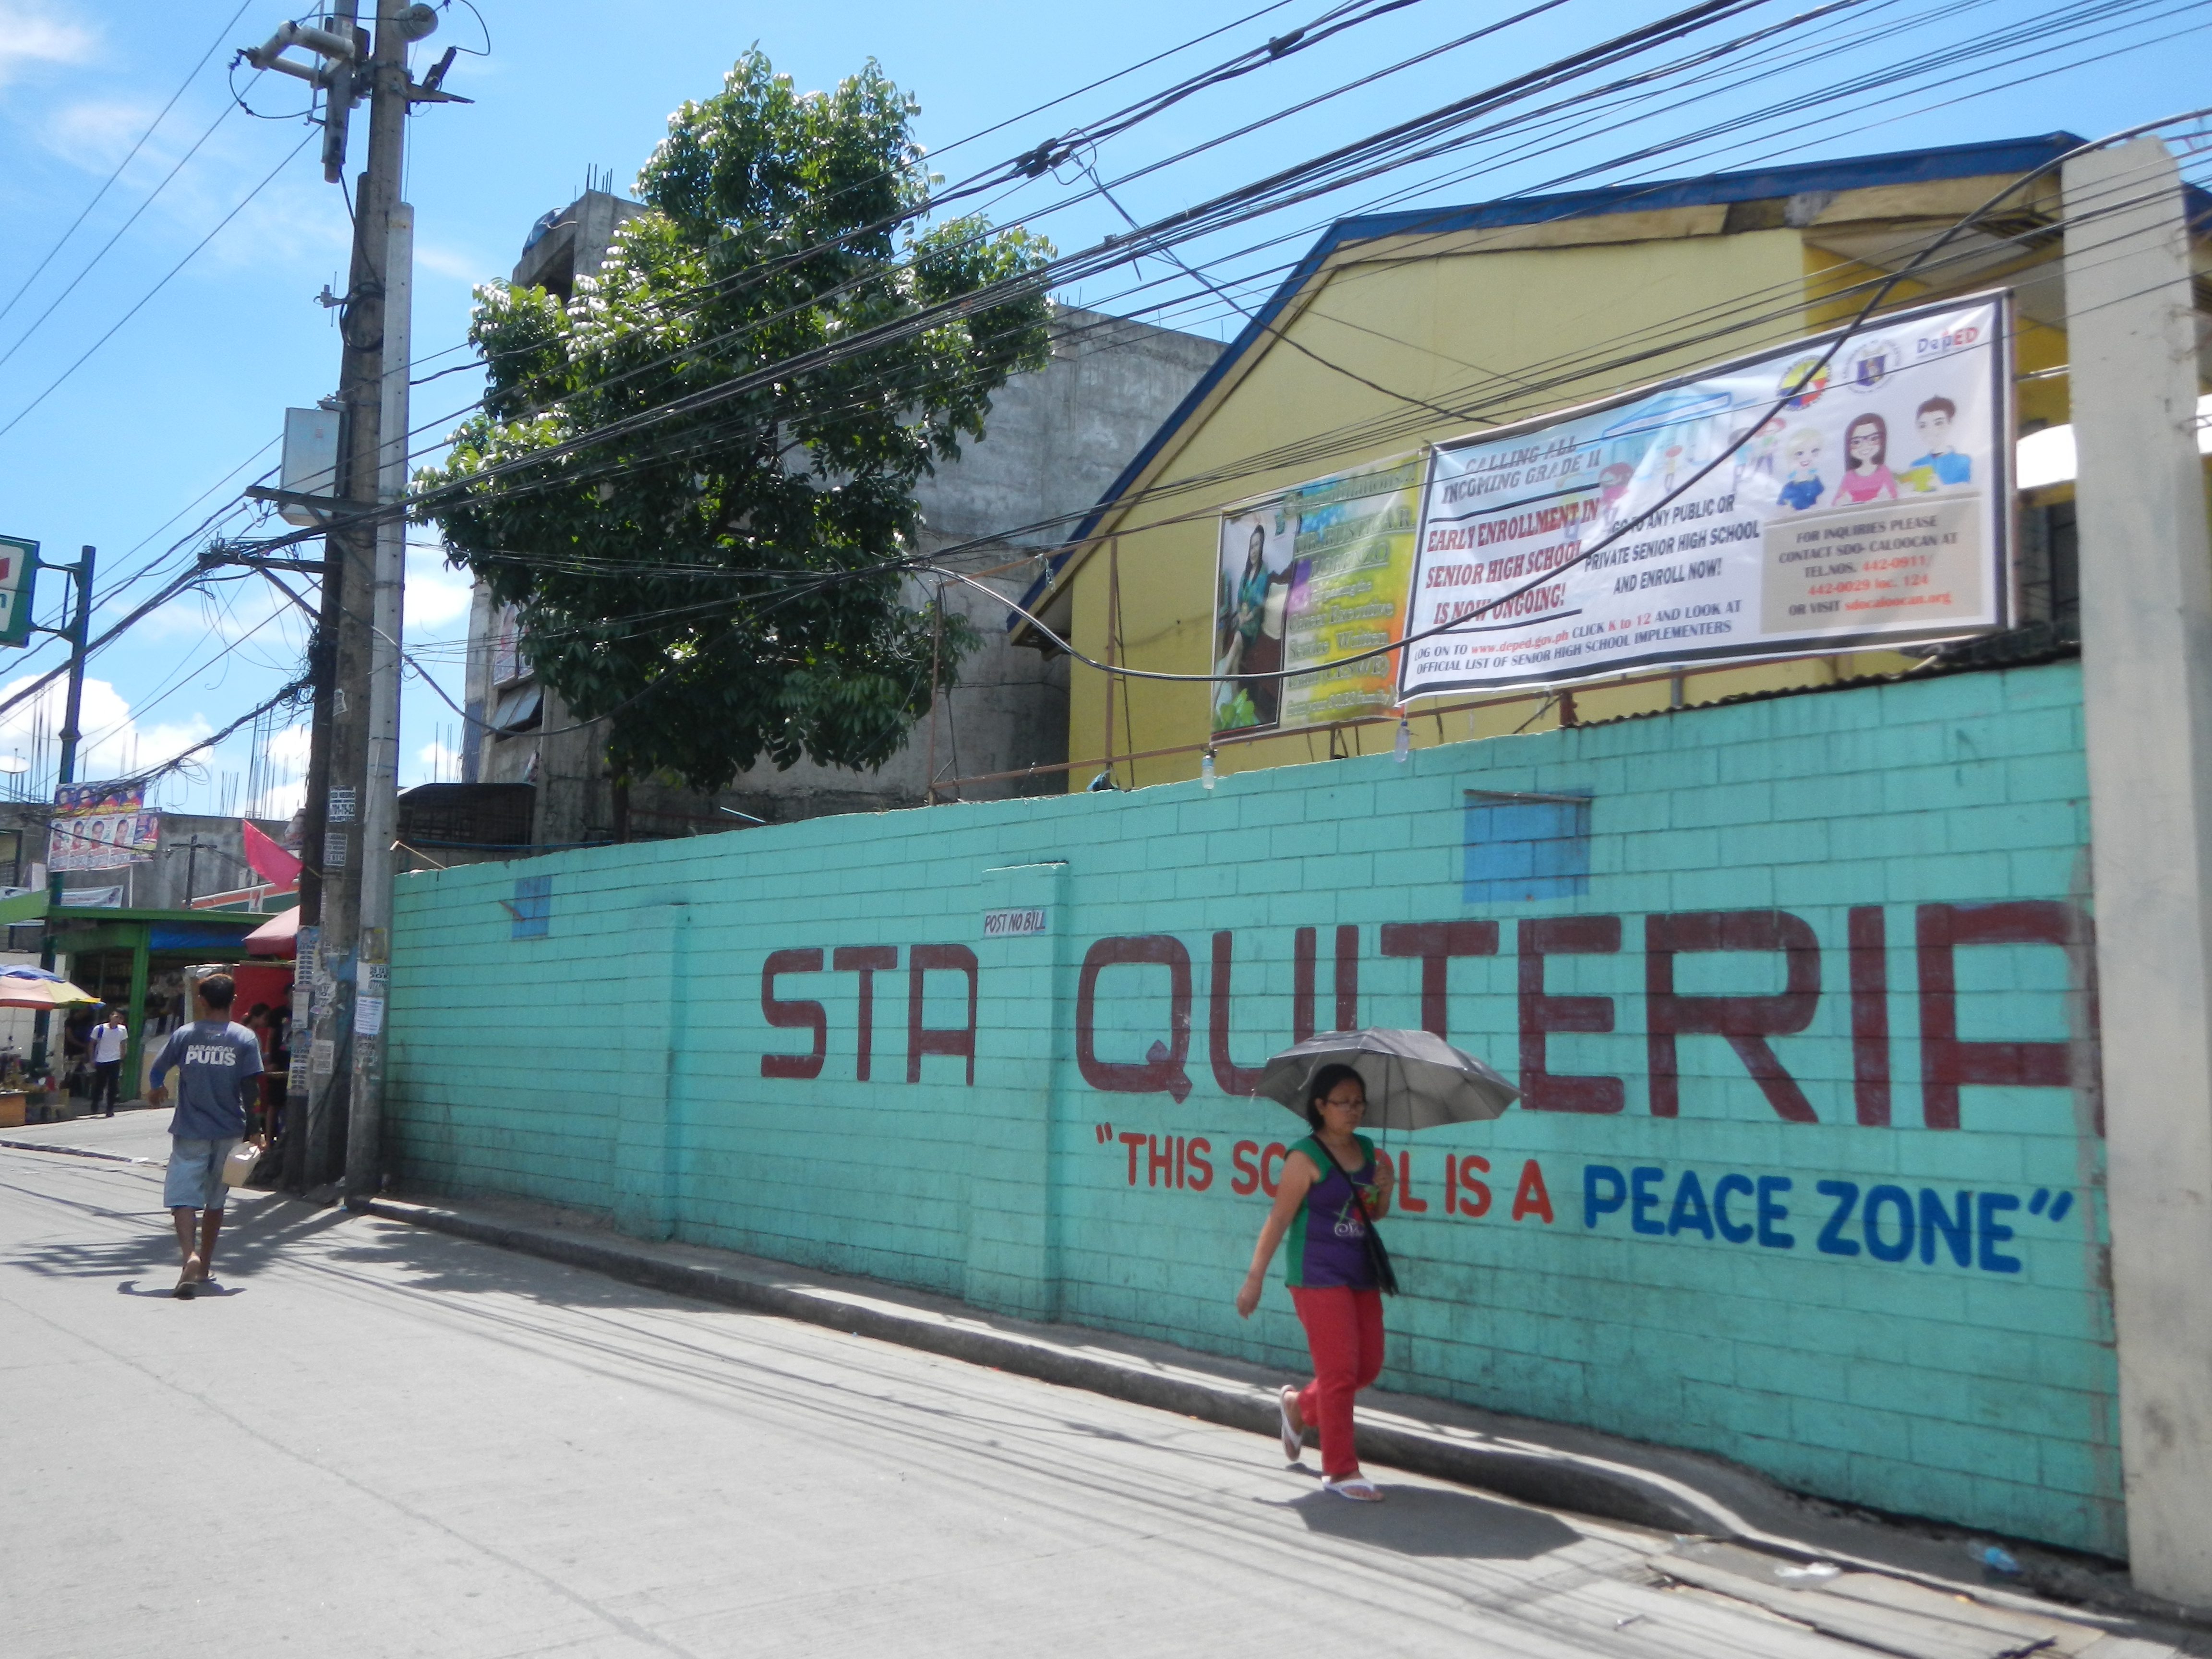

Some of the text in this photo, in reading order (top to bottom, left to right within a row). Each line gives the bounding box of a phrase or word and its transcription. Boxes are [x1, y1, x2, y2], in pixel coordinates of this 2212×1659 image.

[1464, 435, 1578, 475] CALLING ALL
[1441, 469, 1522, 505] INCOMING
[1525, 453, 1585, 485] GRADE
[1427, 497, 1601, 553] EARLY ENROLLMENT IN
[1647, 508, 1671, 529] ANY
[1672, 498, 1715, 524] PUBLIC
[1717, 493, 1735, 514] OR
[1796, 530, 1820, 543] FOR
[1890, 515, 1938, 531] PLEASE
[1425, 539, 1583, 589] SENIOR HIGH SCHOOL
[1585, 519, 1760, 572] PRIVATE SENIOR HIGH SCHOOL
[1779, 545, 1832, 564] CONTACT
[1869, 534, 1938, 552] CALOOCAN
[1942, 531, 1959, 544] AT
[1613, 557, 1722, 595] AND ENROLL NOW!
[1289, 599, 1394, 632] Career Executive
[1433, 582, 1566, 625] IS NOW ONGOING!
[1788, 603, 1806, 616] OR
[1810, 600, 1841, 613] VISIT
[1289, 629, 1389, 661] Service Written
[1414, 599, 1743, 661] LOG ON TO www.deped.gov.ph CLICK K to 12 AND LOOK AT
[1417, 620, 1732, 675] OFFICIAL LIST OF SENIOR HIGH SCHOOL IMPLEMENTERS
[984, 910, 1046, 934] POST NO BILL
[760, 899, 2106, 1138] STA QUITERIA
[185, 1050, 237, 1066] PULIS
[187, 1044, 235, 1053] BARANGAY
[1231, 1139, 1428, 1213] SCL
[1445, 1154, 1492, 1218] IS
[1512, 1158, 1555, 1224] A
[1583, 1164, 1796, 1250] PEACE
